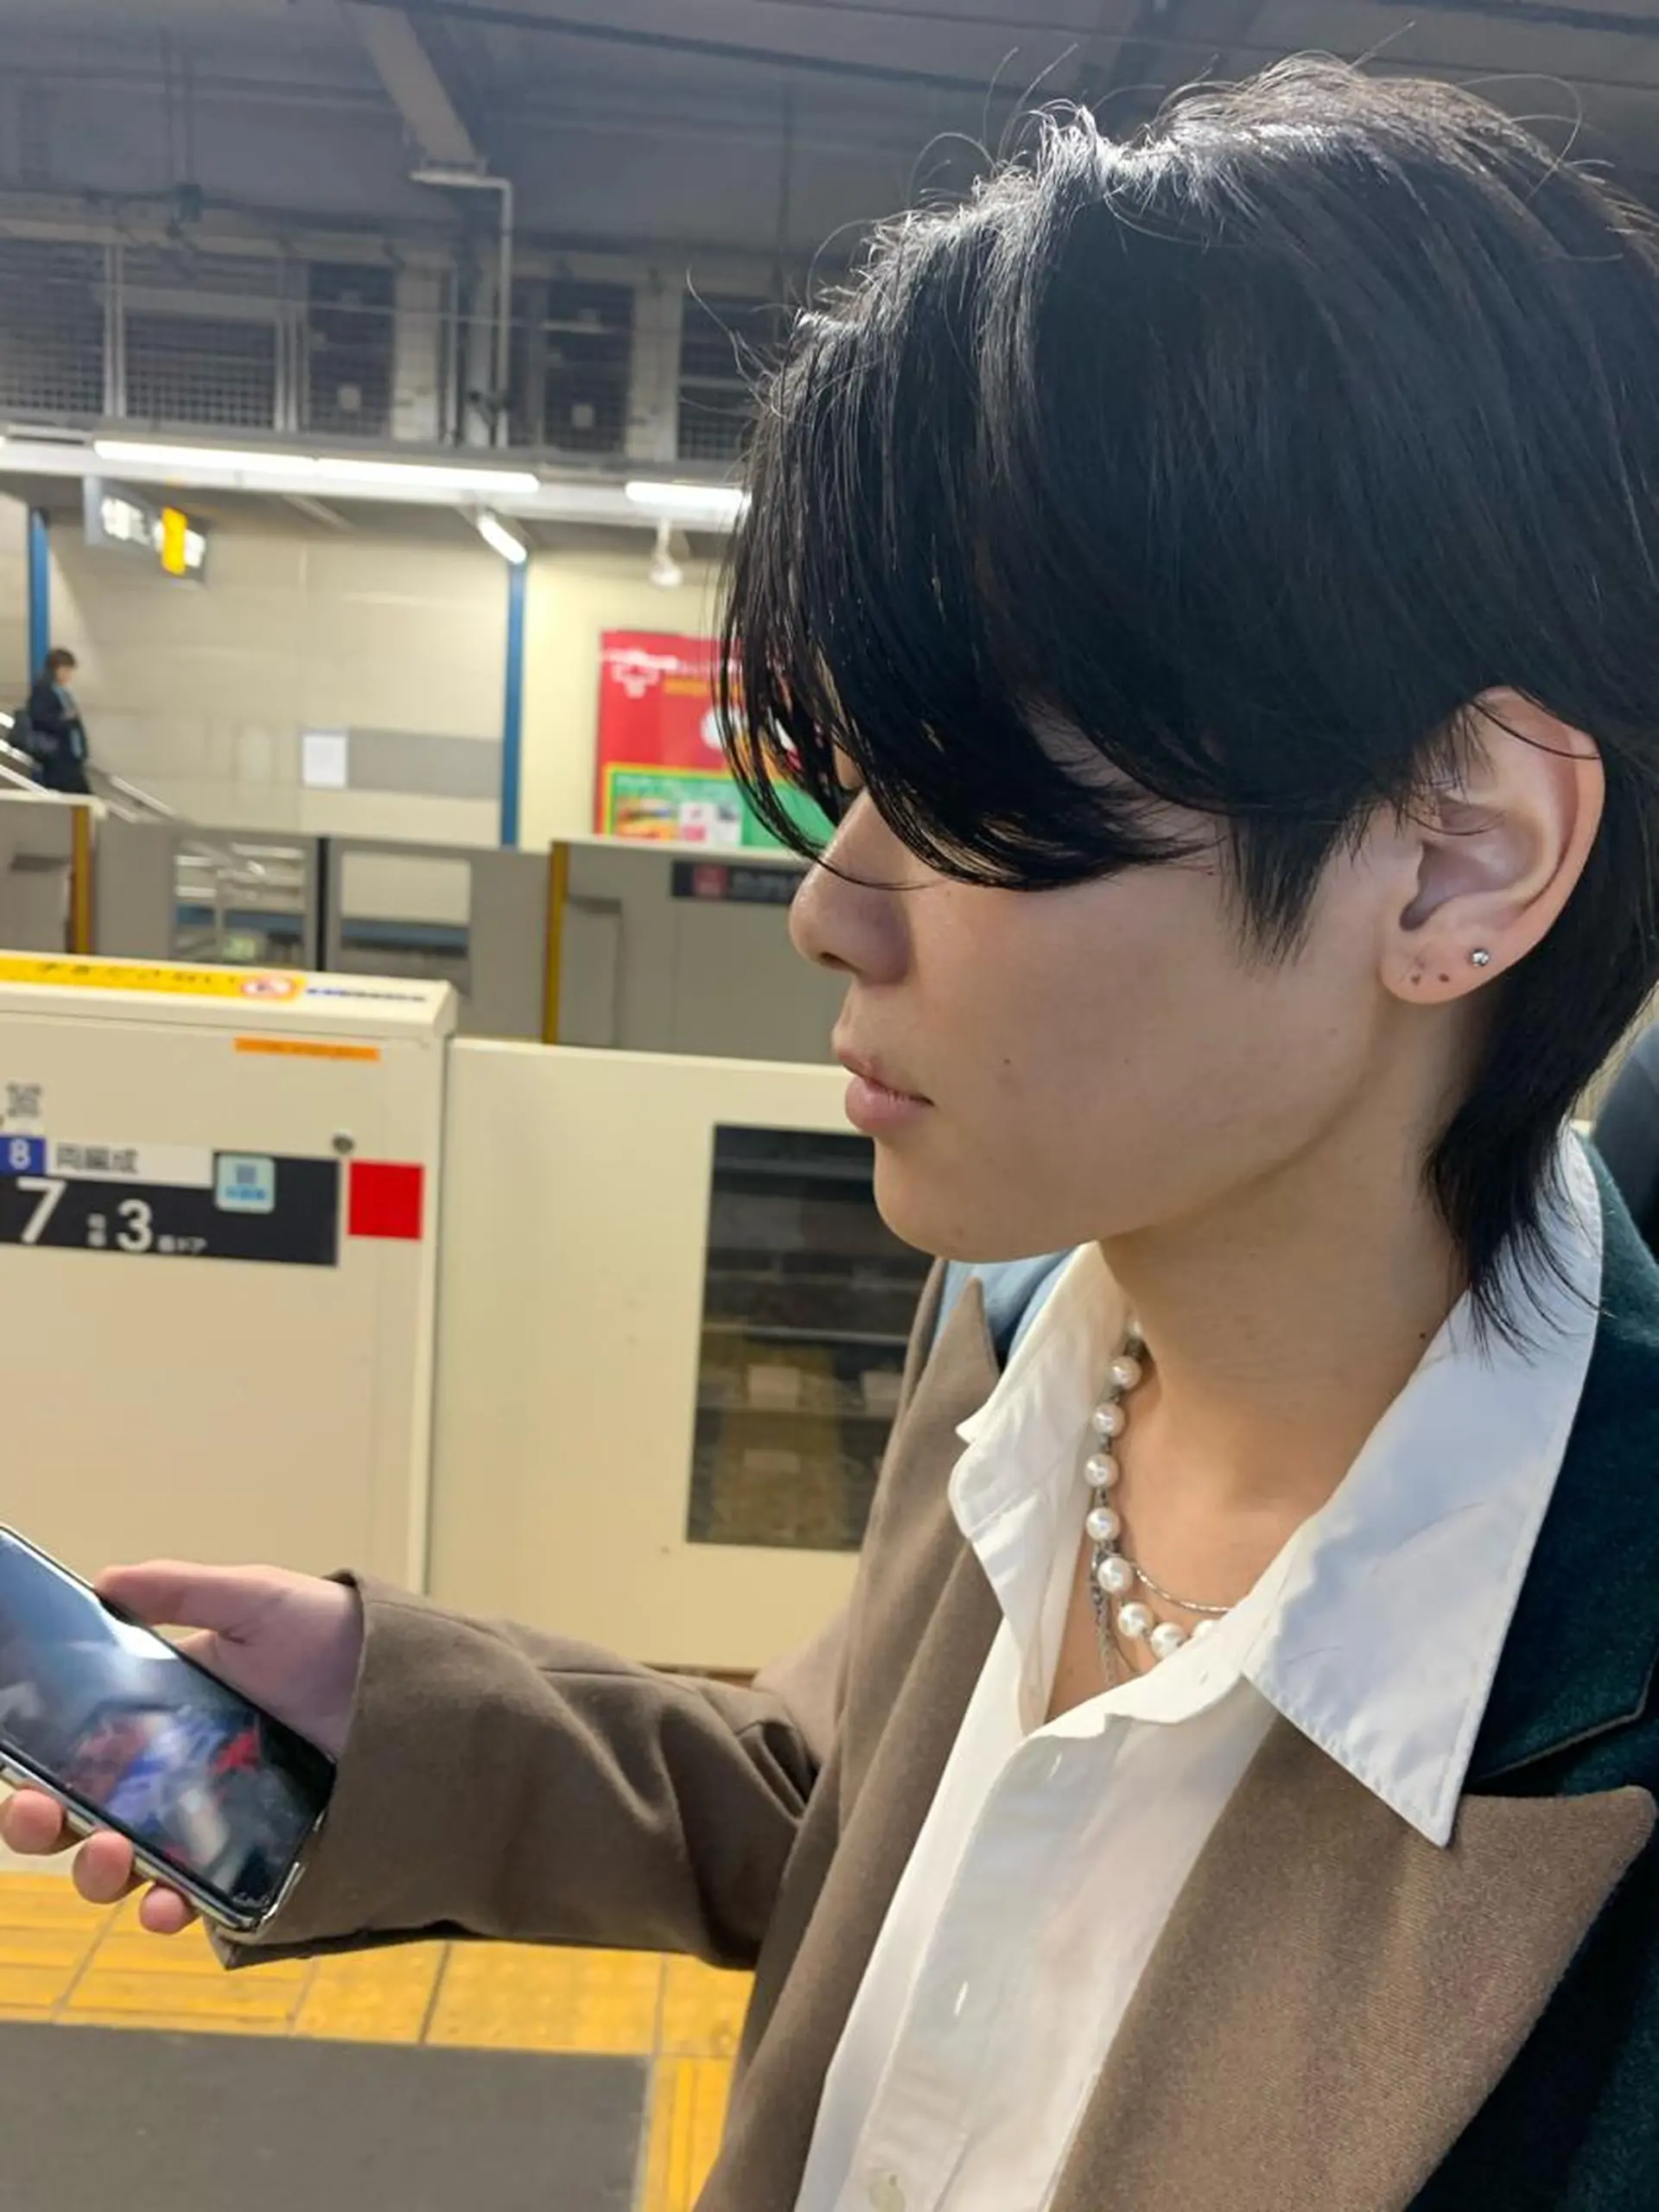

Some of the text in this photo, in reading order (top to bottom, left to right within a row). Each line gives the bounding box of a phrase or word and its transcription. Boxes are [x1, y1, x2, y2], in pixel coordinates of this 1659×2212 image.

[9, 1137, 31, 1170] 8
[16, 1176, 67, 1244] 7
[116, 1198, 153, 1252] 3
